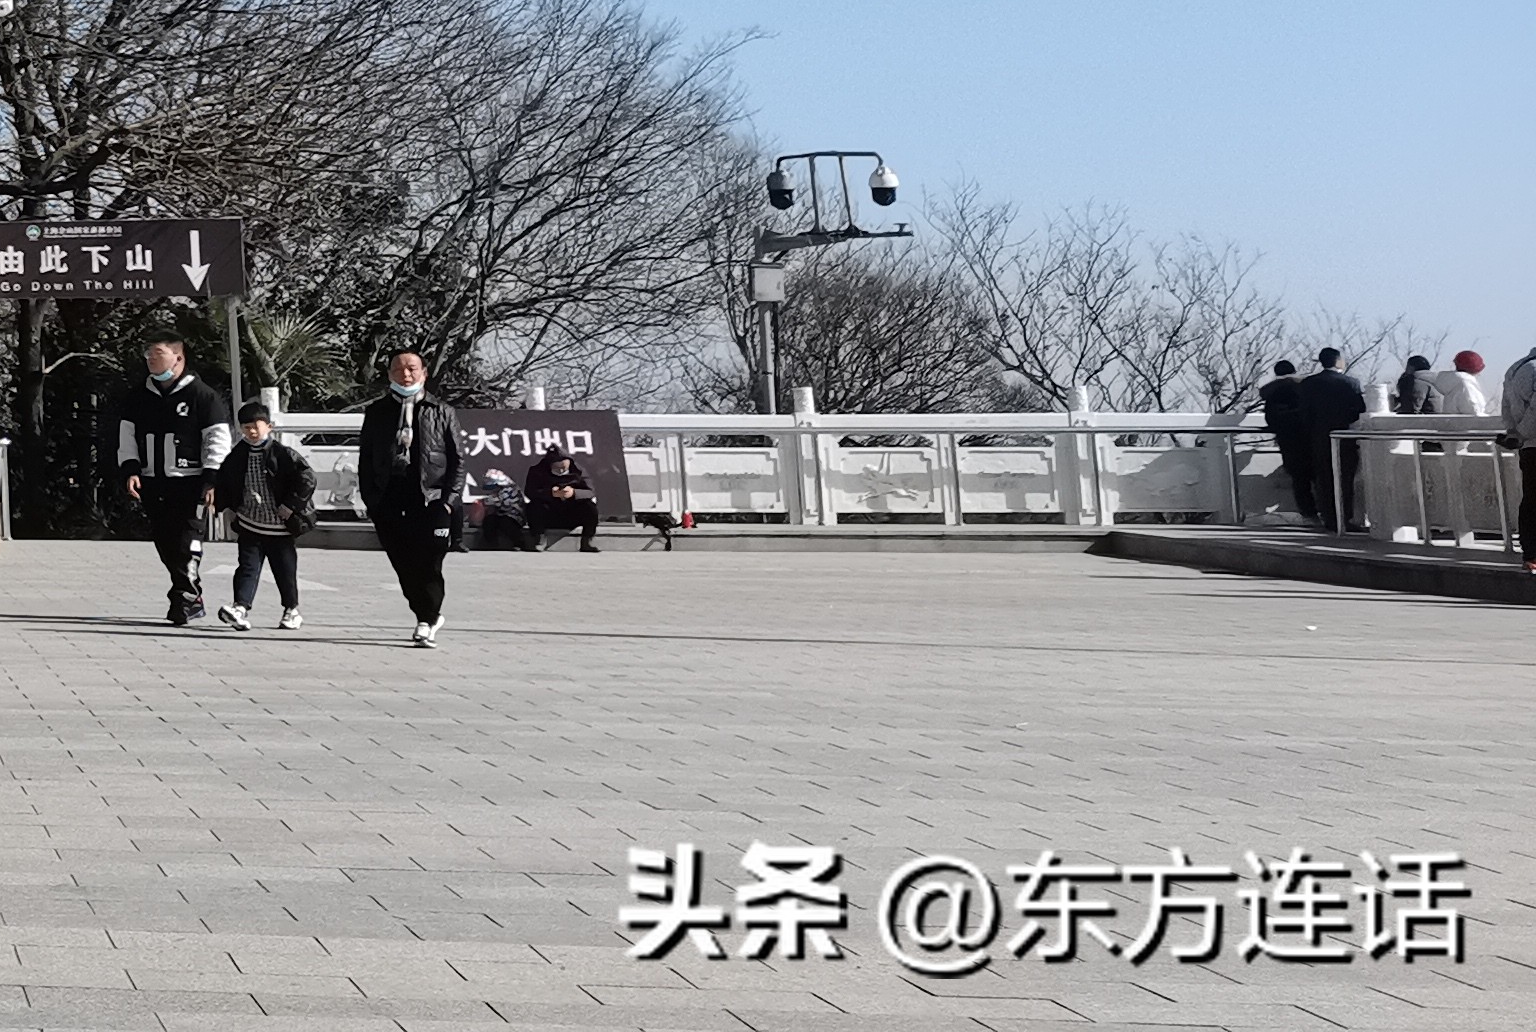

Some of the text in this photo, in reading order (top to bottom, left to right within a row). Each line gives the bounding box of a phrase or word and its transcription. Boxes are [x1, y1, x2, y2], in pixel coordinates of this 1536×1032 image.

[0, 279, 155, 293] Go Down The Hill
